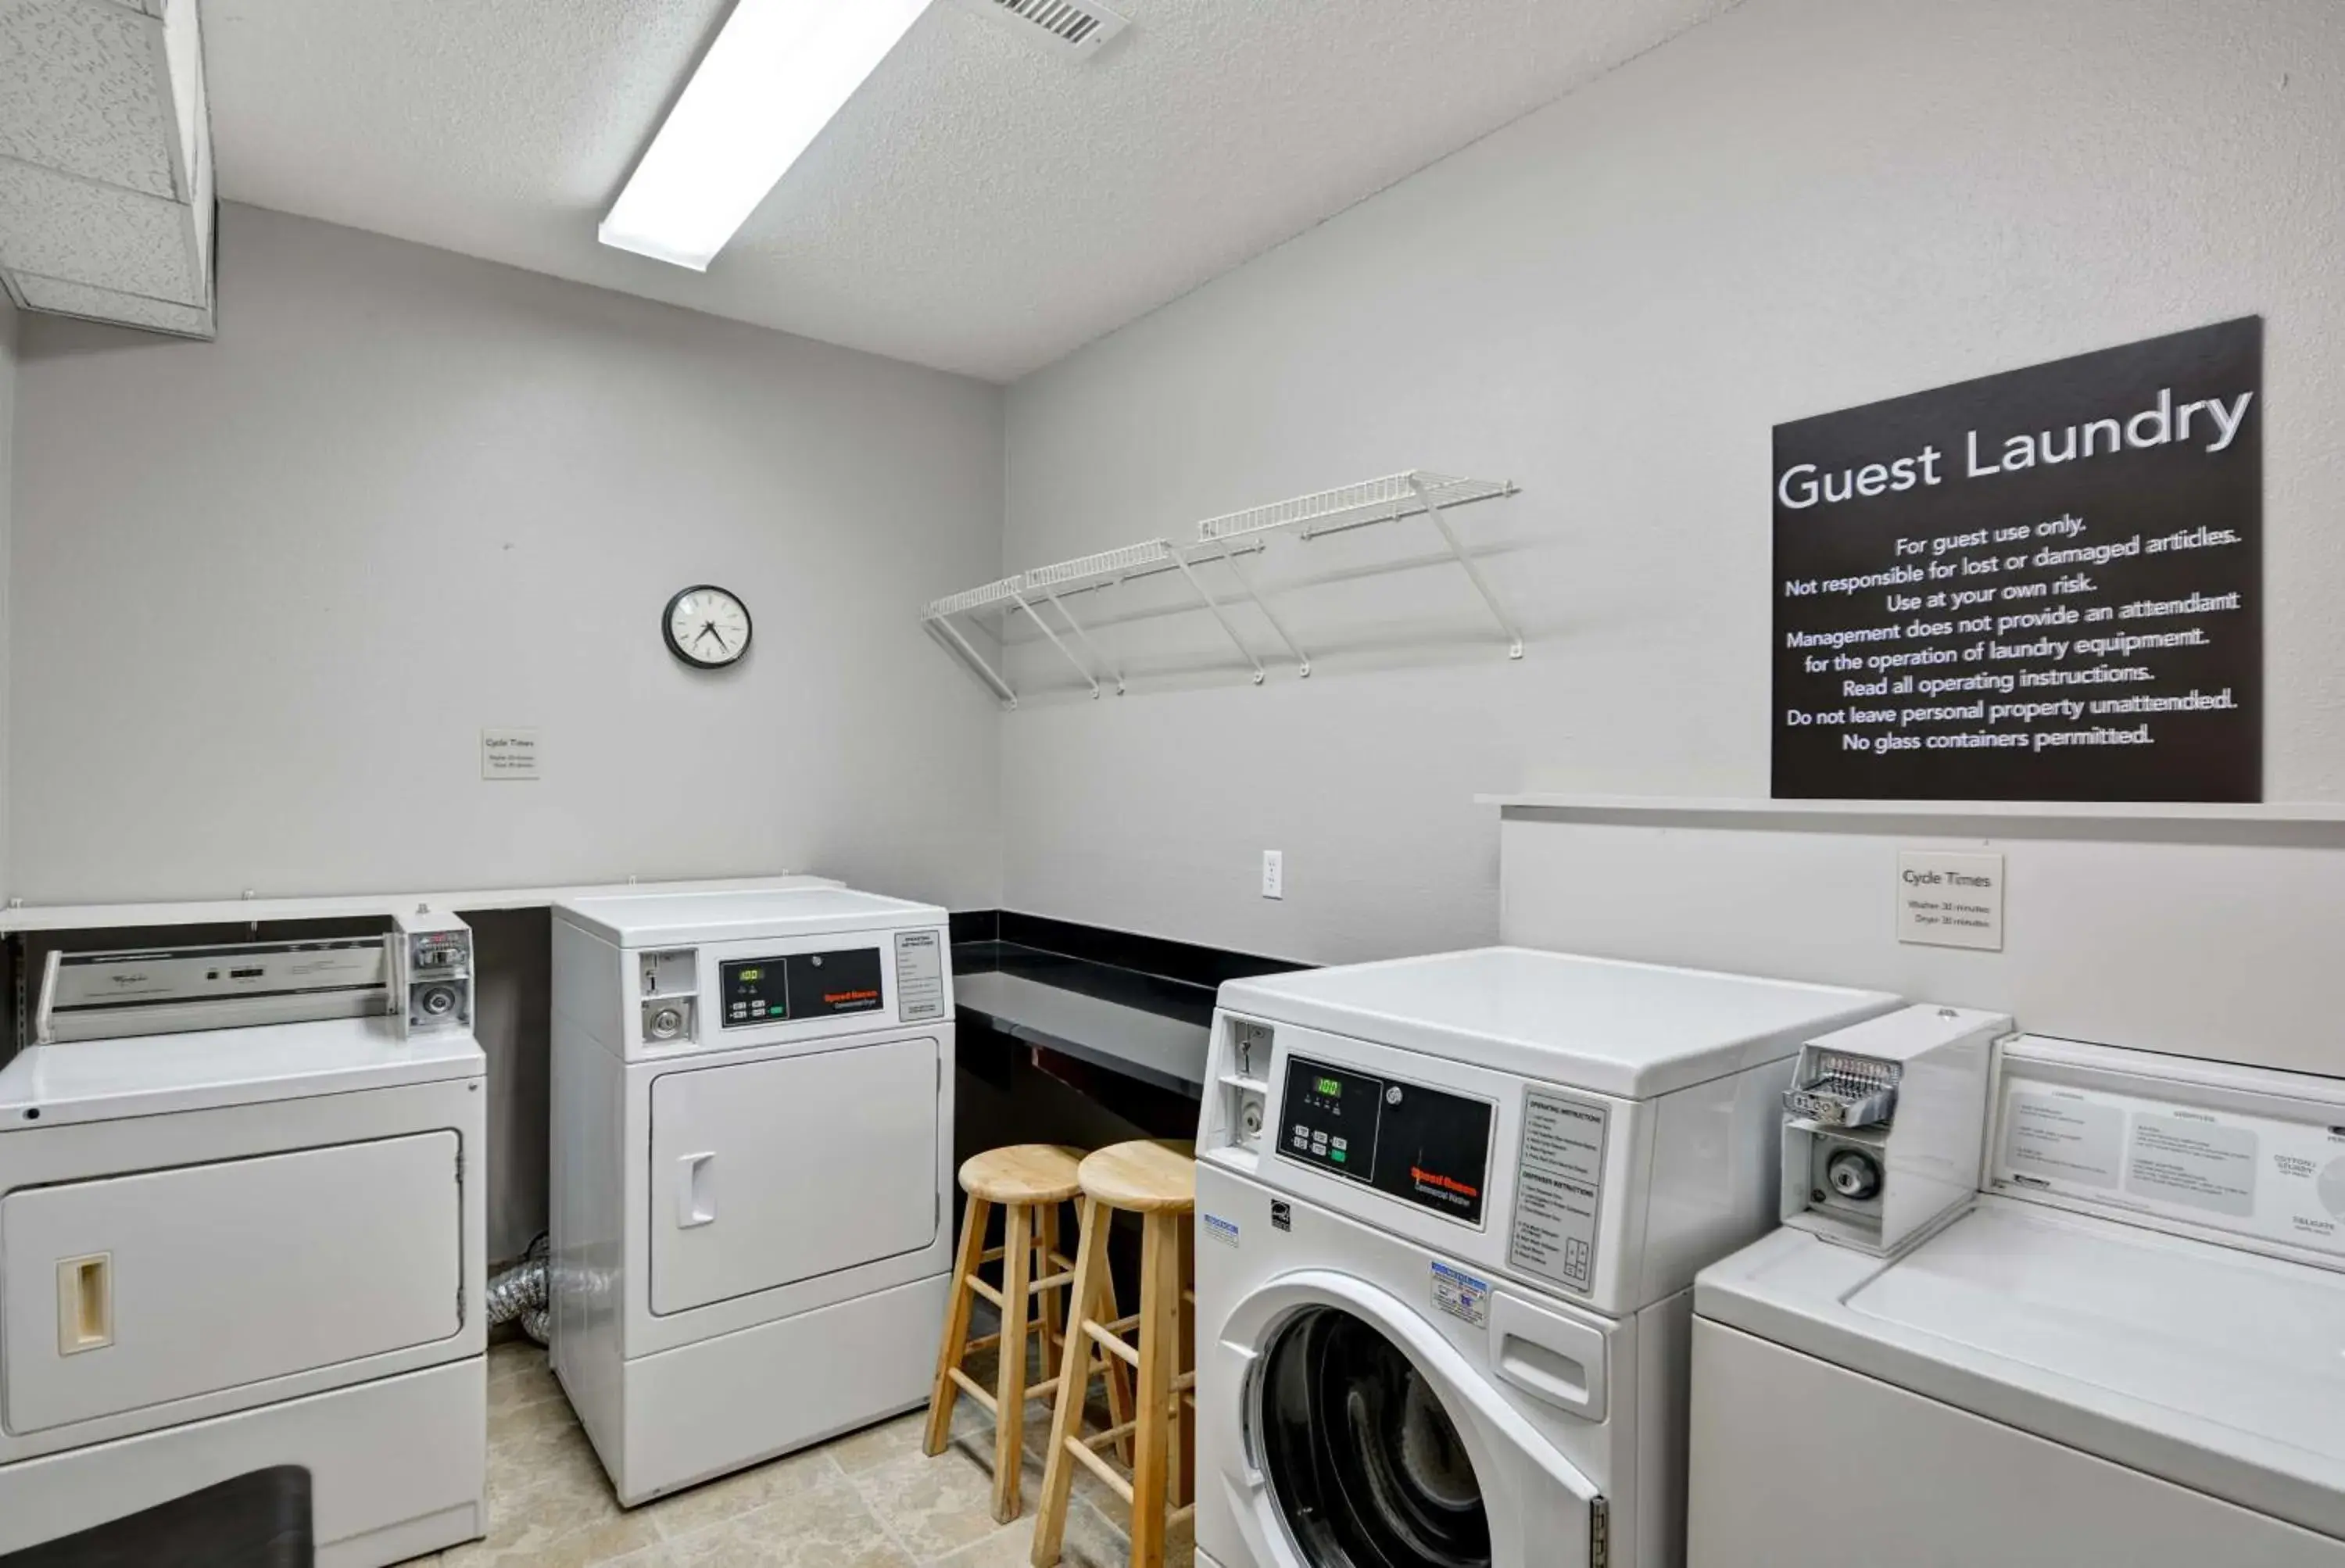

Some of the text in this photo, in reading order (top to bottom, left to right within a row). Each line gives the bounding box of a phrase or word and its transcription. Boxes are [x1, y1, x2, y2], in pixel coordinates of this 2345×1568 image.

[1778, 388, 2254, 510] Guest Laundry
[1895, 513, 2087, 556] For guest use only.
[1785, 525, 2242, 597] Not responsible for lost or damaged articles.
[1886, 572, 2098, 612] Use at your own risk.
[1786, 592, 2241, 649] Management does not provide an attendant
[1804, 628, 2211, 673] for the operation of laundry equipment.
[1842, 664, 2155, 697] Read all operating instructions.
[1786, 687, 2238, 728] Do not leave personal property unattended.
[1842, 723, 2155, 754] No glass containers permitted.
[1903, 869, 1992, 888] Cycle Times
